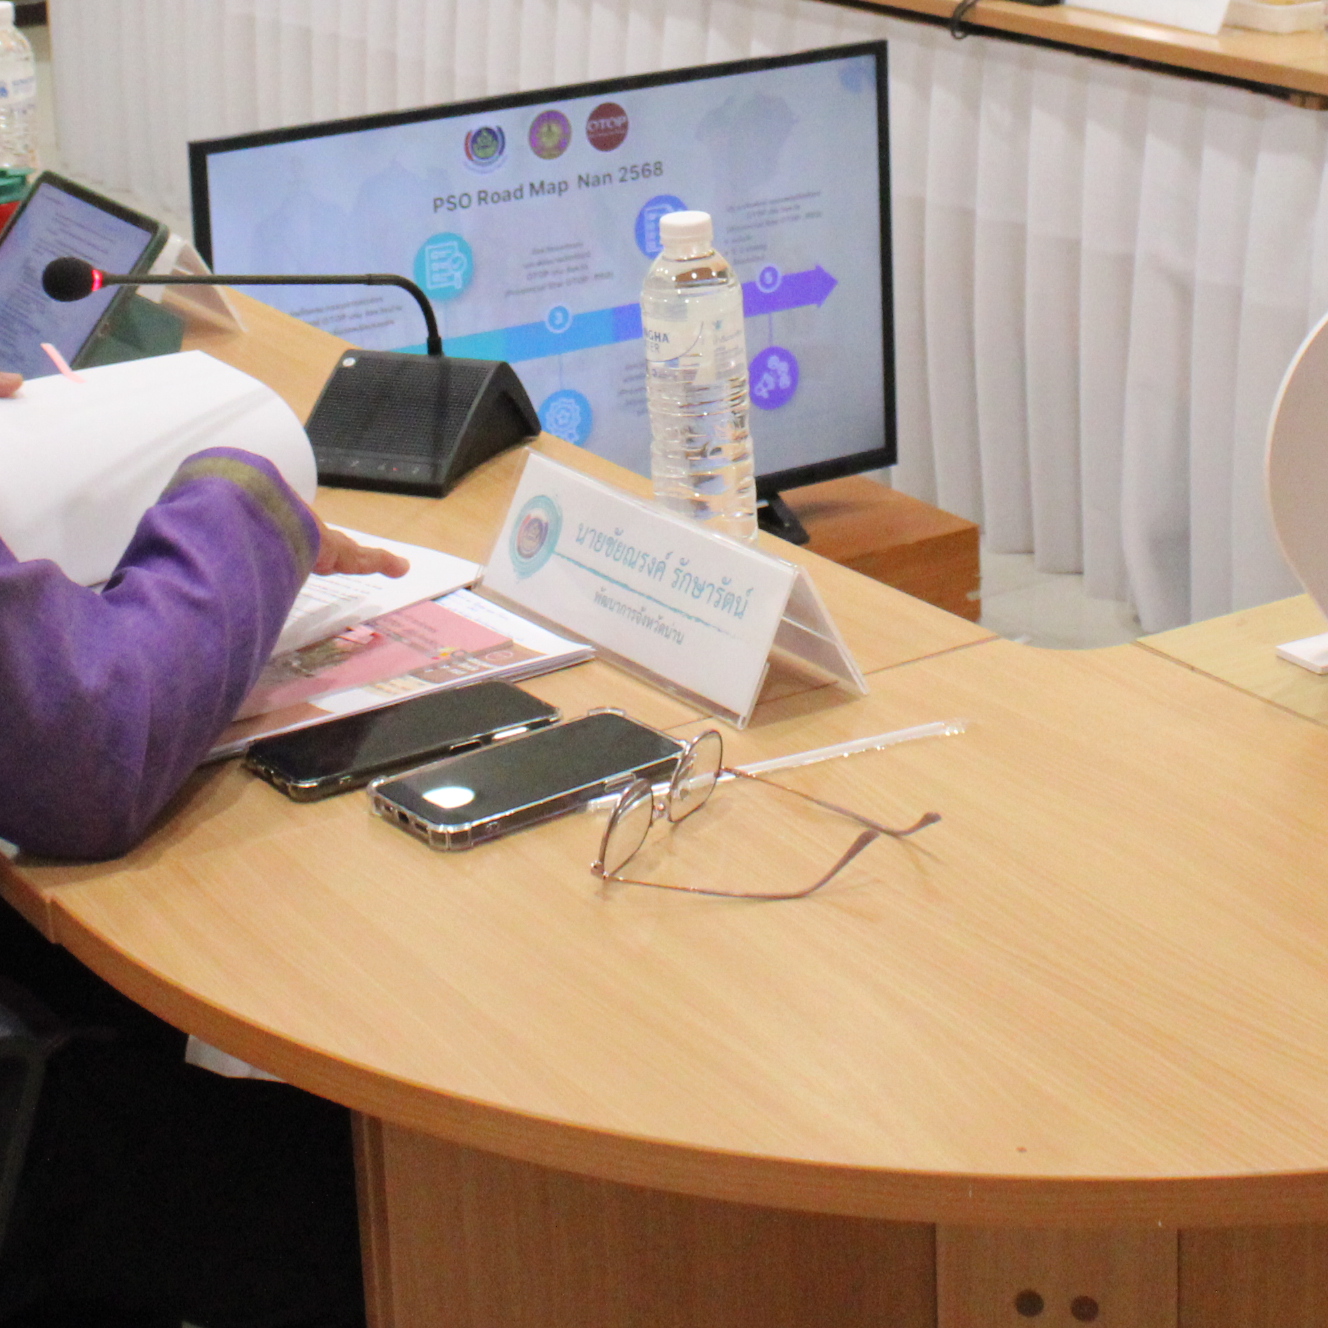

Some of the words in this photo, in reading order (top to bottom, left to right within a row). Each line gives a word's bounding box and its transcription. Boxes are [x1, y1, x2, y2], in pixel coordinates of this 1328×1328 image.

[587, 114, 627, 134] OTOP
[432, 193, 472, 213] PSO
[477, 184, 524, 207] Road
[529, 179, 569, 198] Map
[577, 172, 613, 190] Nan
[618, 161, 663, 183] 2568
[575, 523, 674, 582] นายชัยณรงค์
[671, 557, 754, 619] รักษารัตน์
[593, 586, 685, 645] พัฒนาการจังหวัดน่าน
